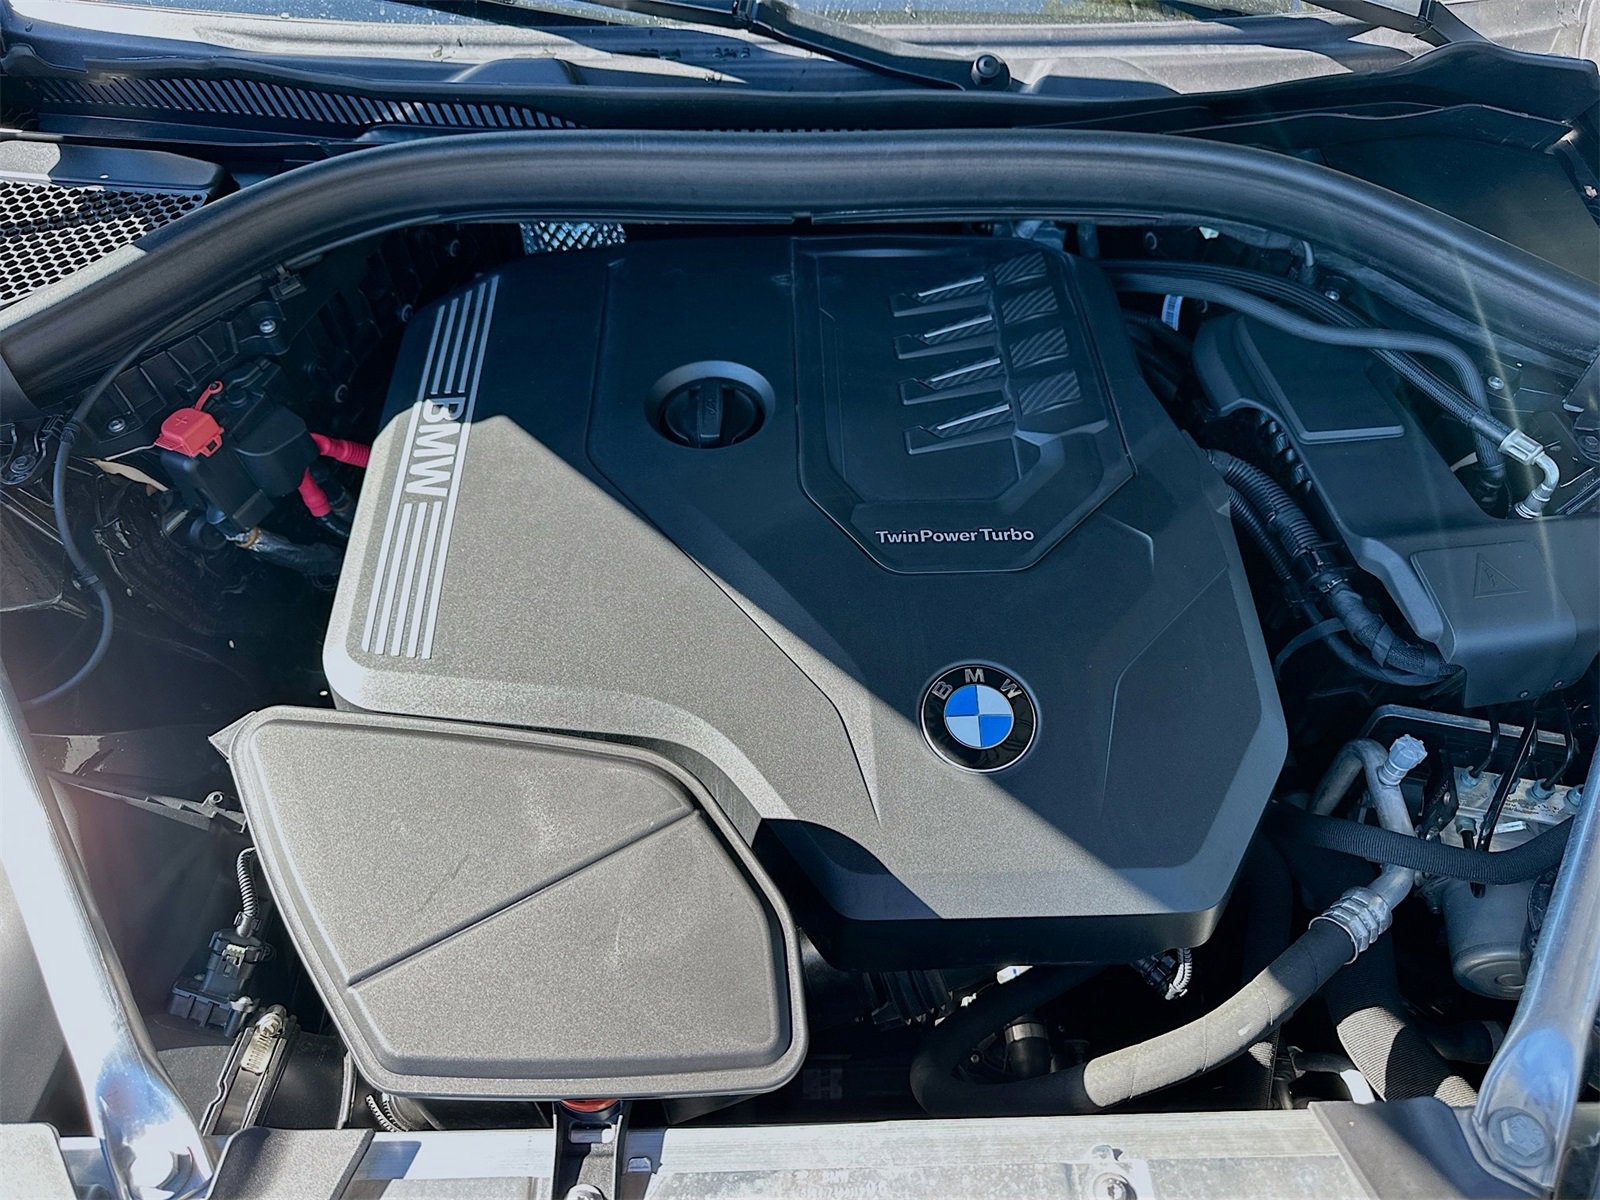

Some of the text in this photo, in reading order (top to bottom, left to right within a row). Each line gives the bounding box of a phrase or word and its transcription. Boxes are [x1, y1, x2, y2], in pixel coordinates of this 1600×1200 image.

[406, 397, 466, 497] BMW
[875, 528, 1034, 543] TwinPower Turbo
[931, 668, 1022, 700] BMW
